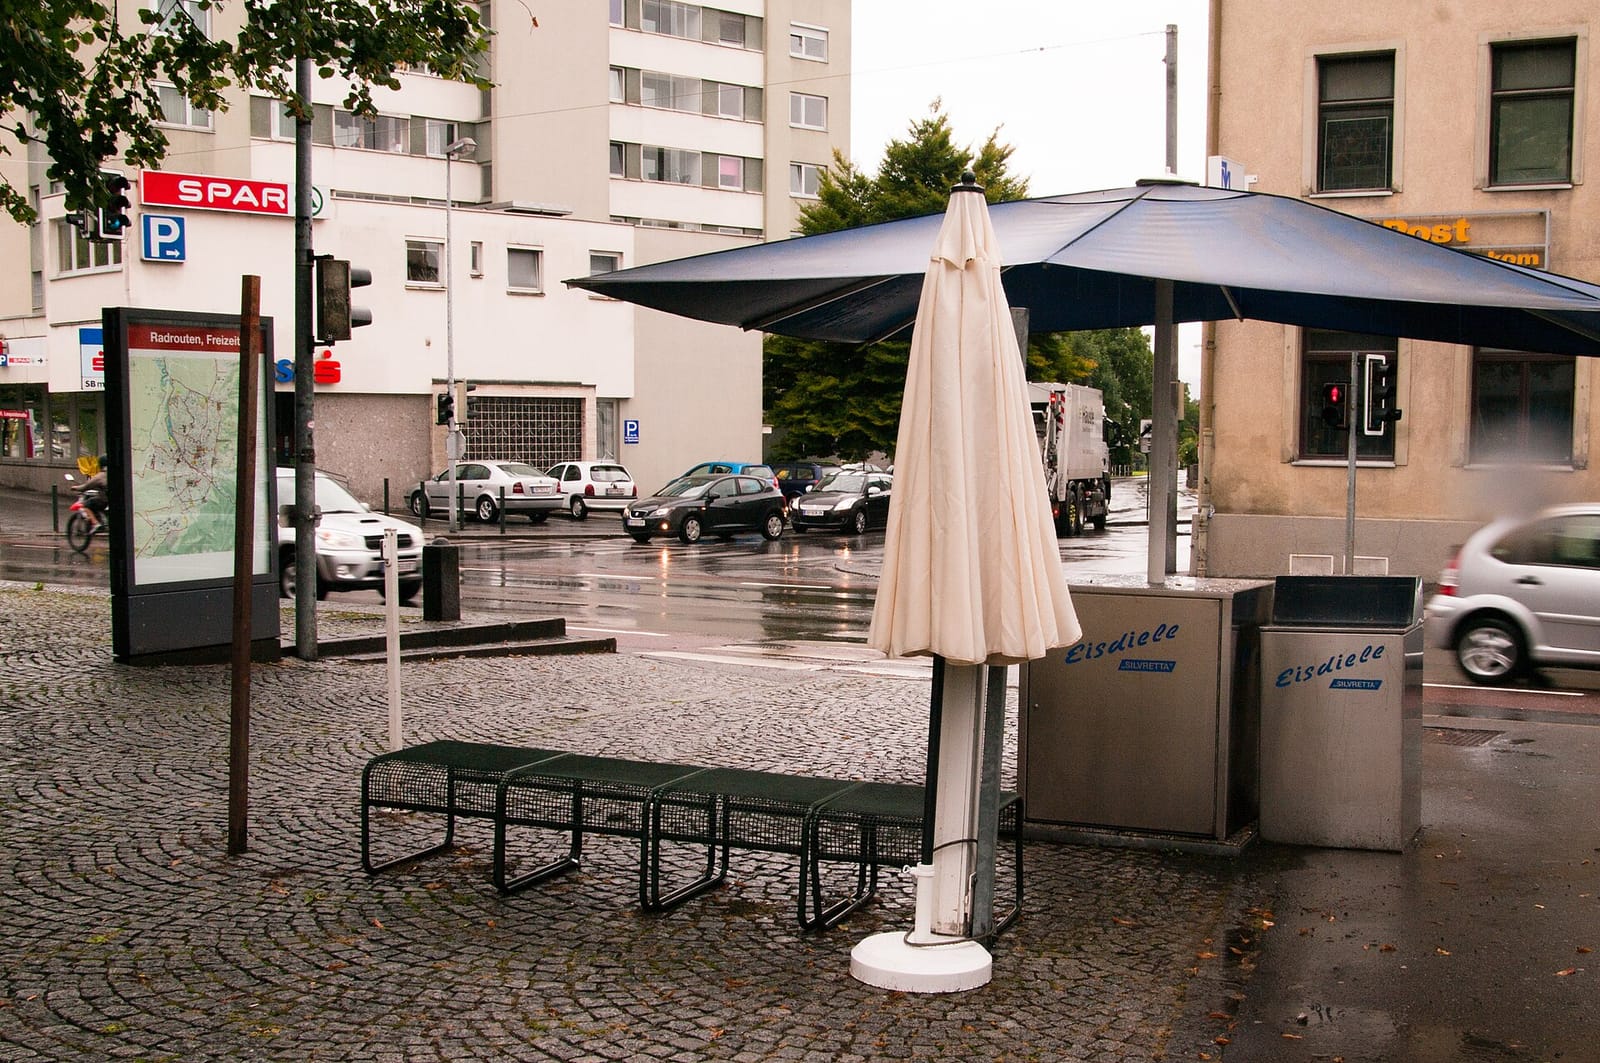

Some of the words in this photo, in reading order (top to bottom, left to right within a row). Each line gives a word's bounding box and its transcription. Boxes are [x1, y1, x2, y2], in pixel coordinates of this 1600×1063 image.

[178, 180, 286, 209] SPAR
[150, 217, 180, 258] P
[150, 331, 204, 346] Radrouten,
[206, 334, 241, 346] Freizeit
[626, 421, 637, 437] P
[1065, 623, 1179, 664] Eisdiele
[1275, 645, 1385, 688] Eisdiele
